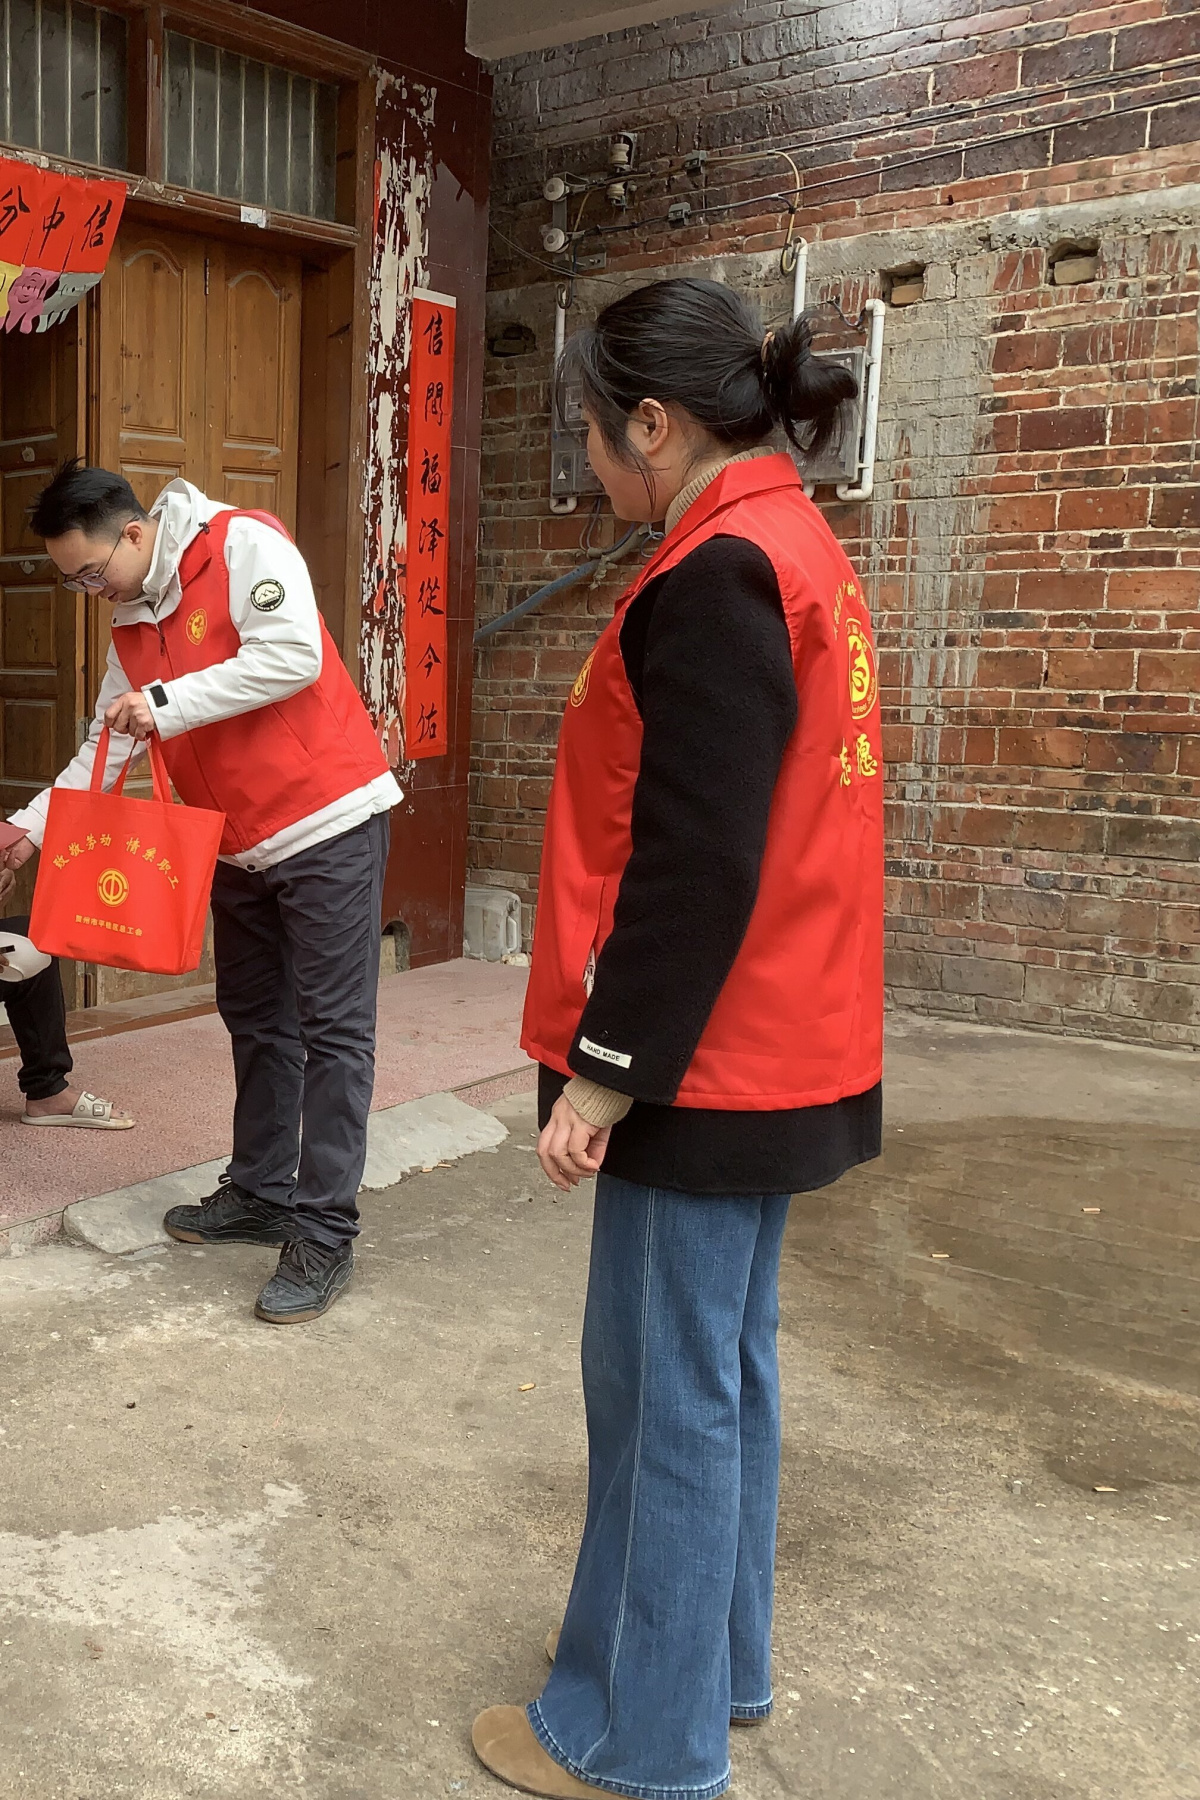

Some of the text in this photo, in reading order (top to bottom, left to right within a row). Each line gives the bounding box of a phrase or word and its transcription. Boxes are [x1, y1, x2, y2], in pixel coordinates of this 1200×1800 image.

[126, 837, 179, 890] 情系职工
[587, 1044, 620, 1061] HAND MADE
